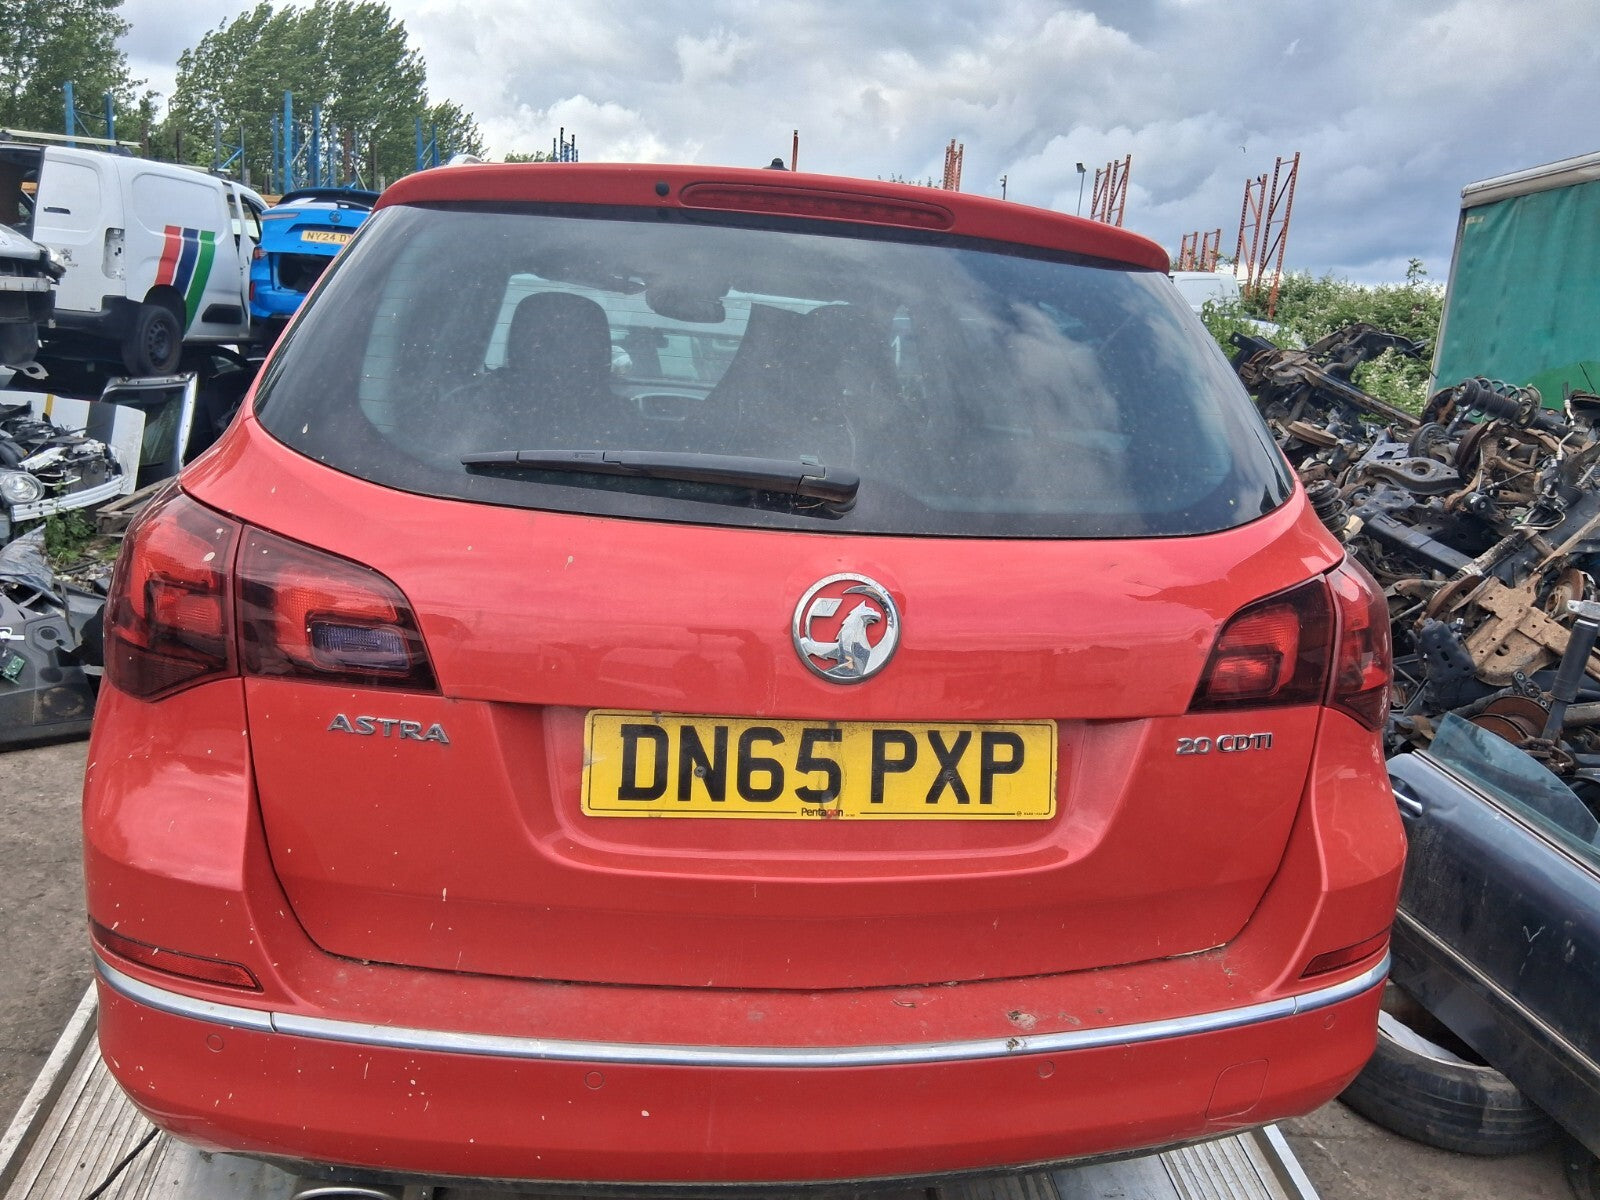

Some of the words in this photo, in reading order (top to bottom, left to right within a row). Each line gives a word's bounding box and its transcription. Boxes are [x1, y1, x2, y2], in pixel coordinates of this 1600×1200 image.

[306, 231, 336, 242] NY24
[327, 713, 450, 744] ASTRA
[1216, 732, 1273, 753] CDTI
[618, 723, 843, 803] DN65
[871, 729, 1025, 804] PXP
[801, 808, 844, 818] Pentagon
